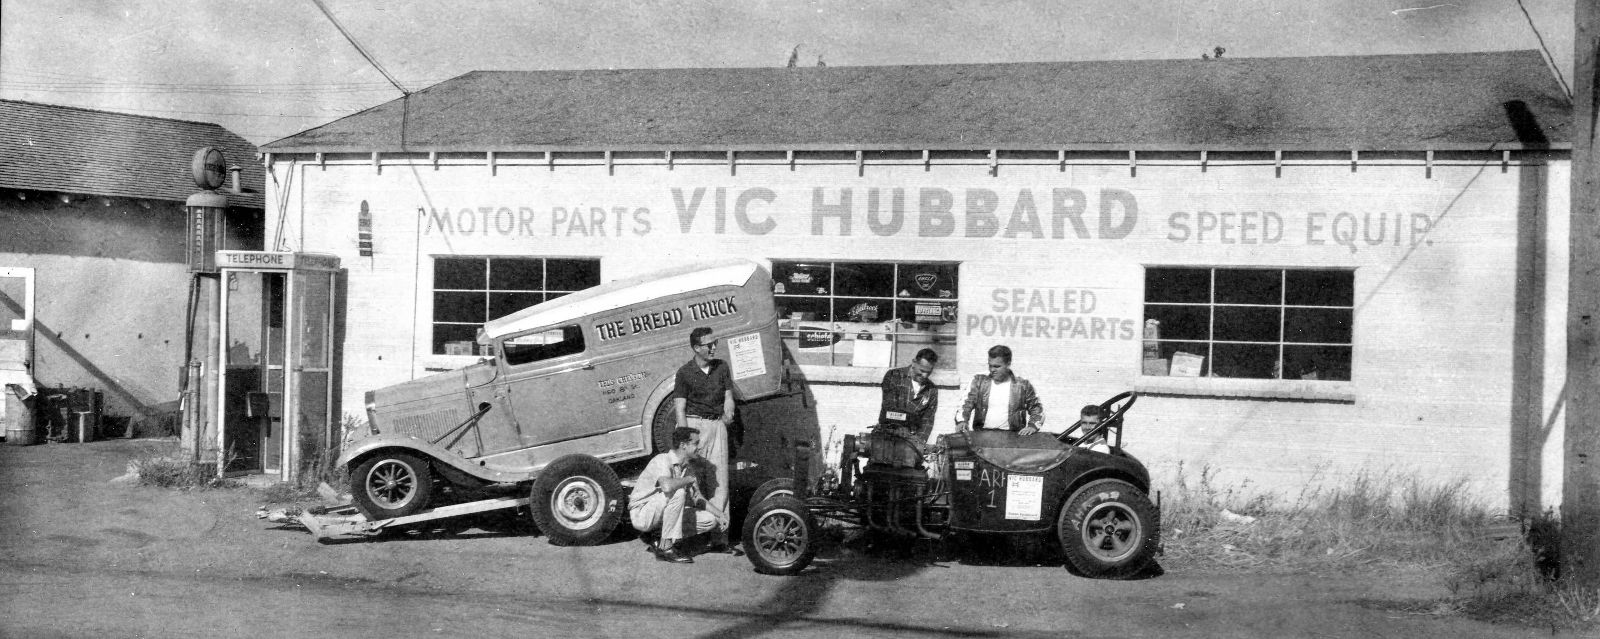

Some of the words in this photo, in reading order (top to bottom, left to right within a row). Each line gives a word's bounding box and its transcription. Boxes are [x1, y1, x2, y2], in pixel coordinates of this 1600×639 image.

[424, 206, 535, 236] MOTOR
[551, 206, 652, 237] PARTS
[670, 187, 778, 235] VIC
[811, 186, 1139, 240] HUBBARD
[1167, 211, 1284, 244] SPEED
[1305, 211, 1434, 254] EQUIP.
[226, 253, 283, 265] TELEPHONE
[991, 288, 1097, 314] SEALED
[595, 320, 626, 341] THE
[630, 307, 683, 335] BREAD
[687, 295, 738, 321] TRUCK
[986, 489, 997, 508] 1
